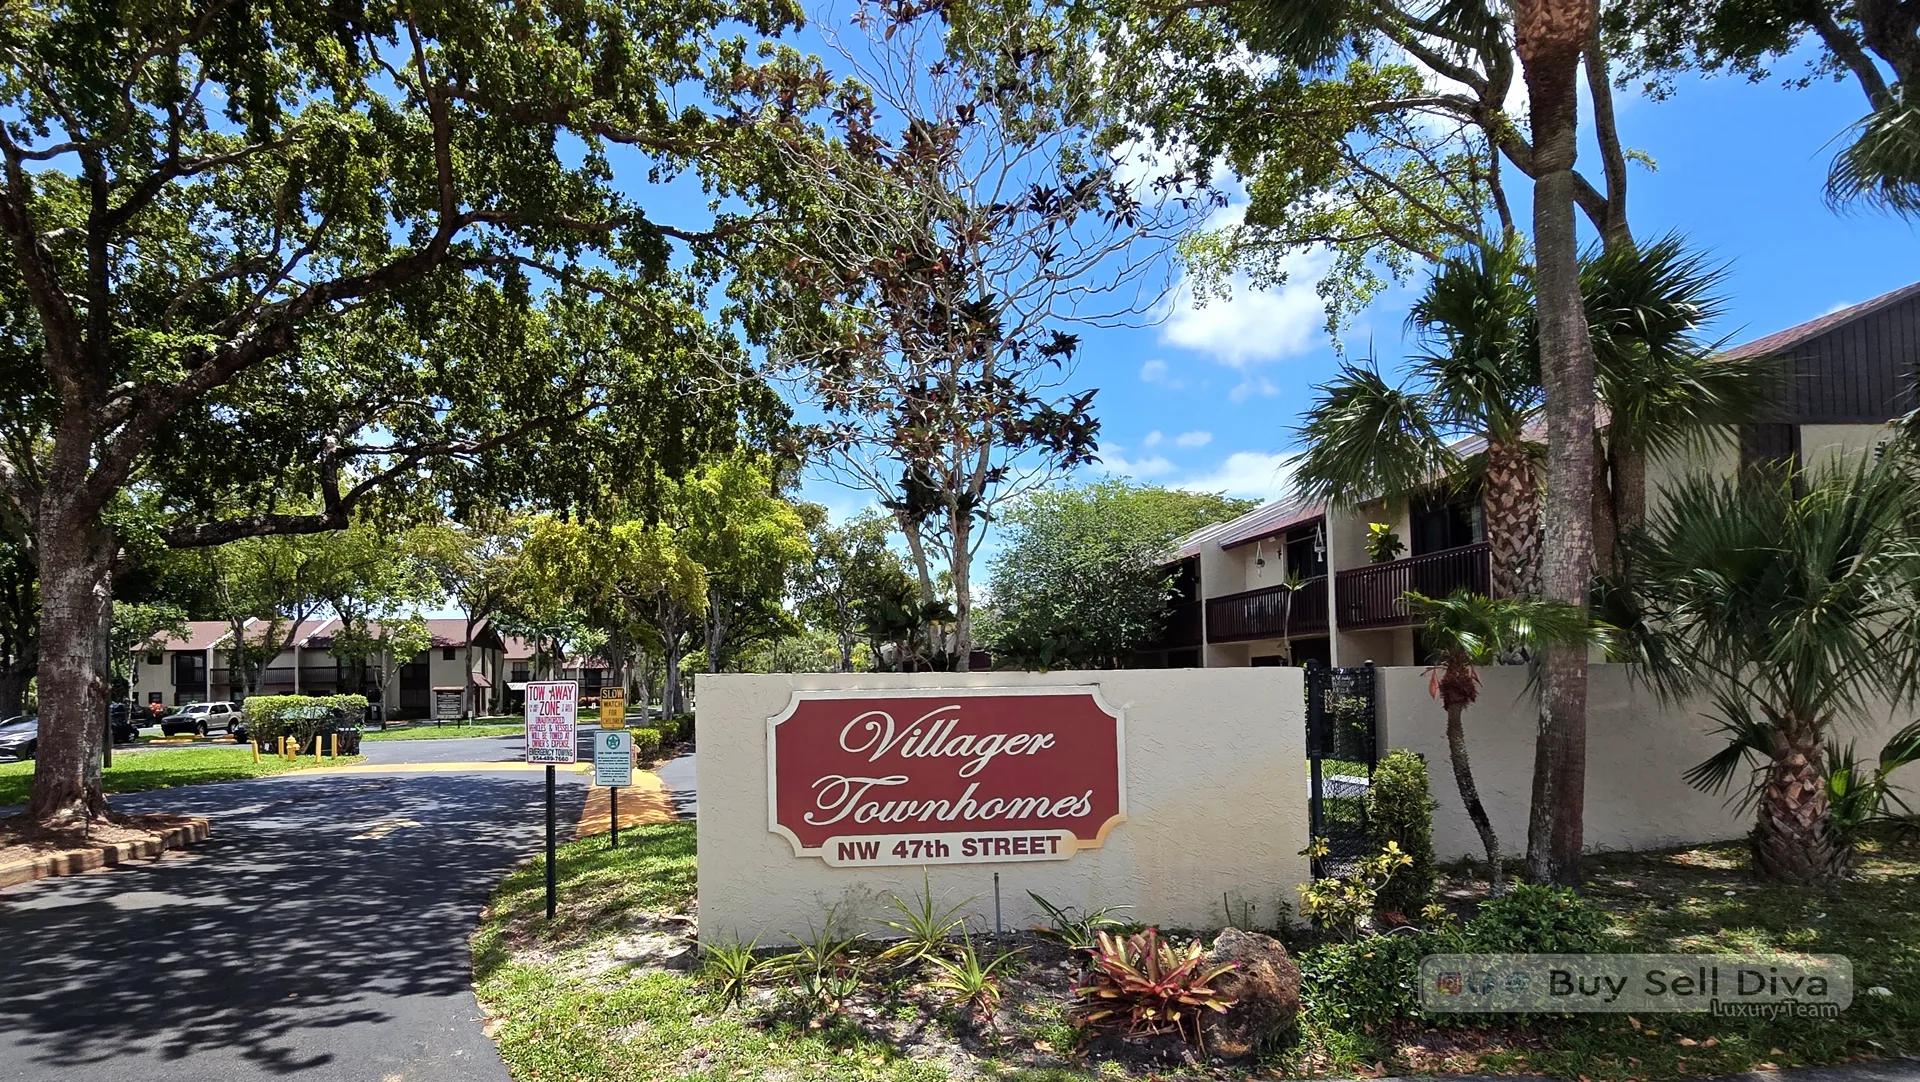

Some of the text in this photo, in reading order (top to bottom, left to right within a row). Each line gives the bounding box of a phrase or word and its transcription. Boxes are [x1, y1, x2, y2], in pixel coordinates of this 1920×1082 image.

[529, 686, 545, 700] TOW
[602, 689, 623, 698] SLOW
[540, 701, 560, 715] ZONE
[839, 704, 1056, 778] Villager
[529, 748, 573, 757] EMERGENCY TOWING
[803, 774, 1093, 826] Townhomes
[838, 835, 1062, 861] NW 47th STREET
